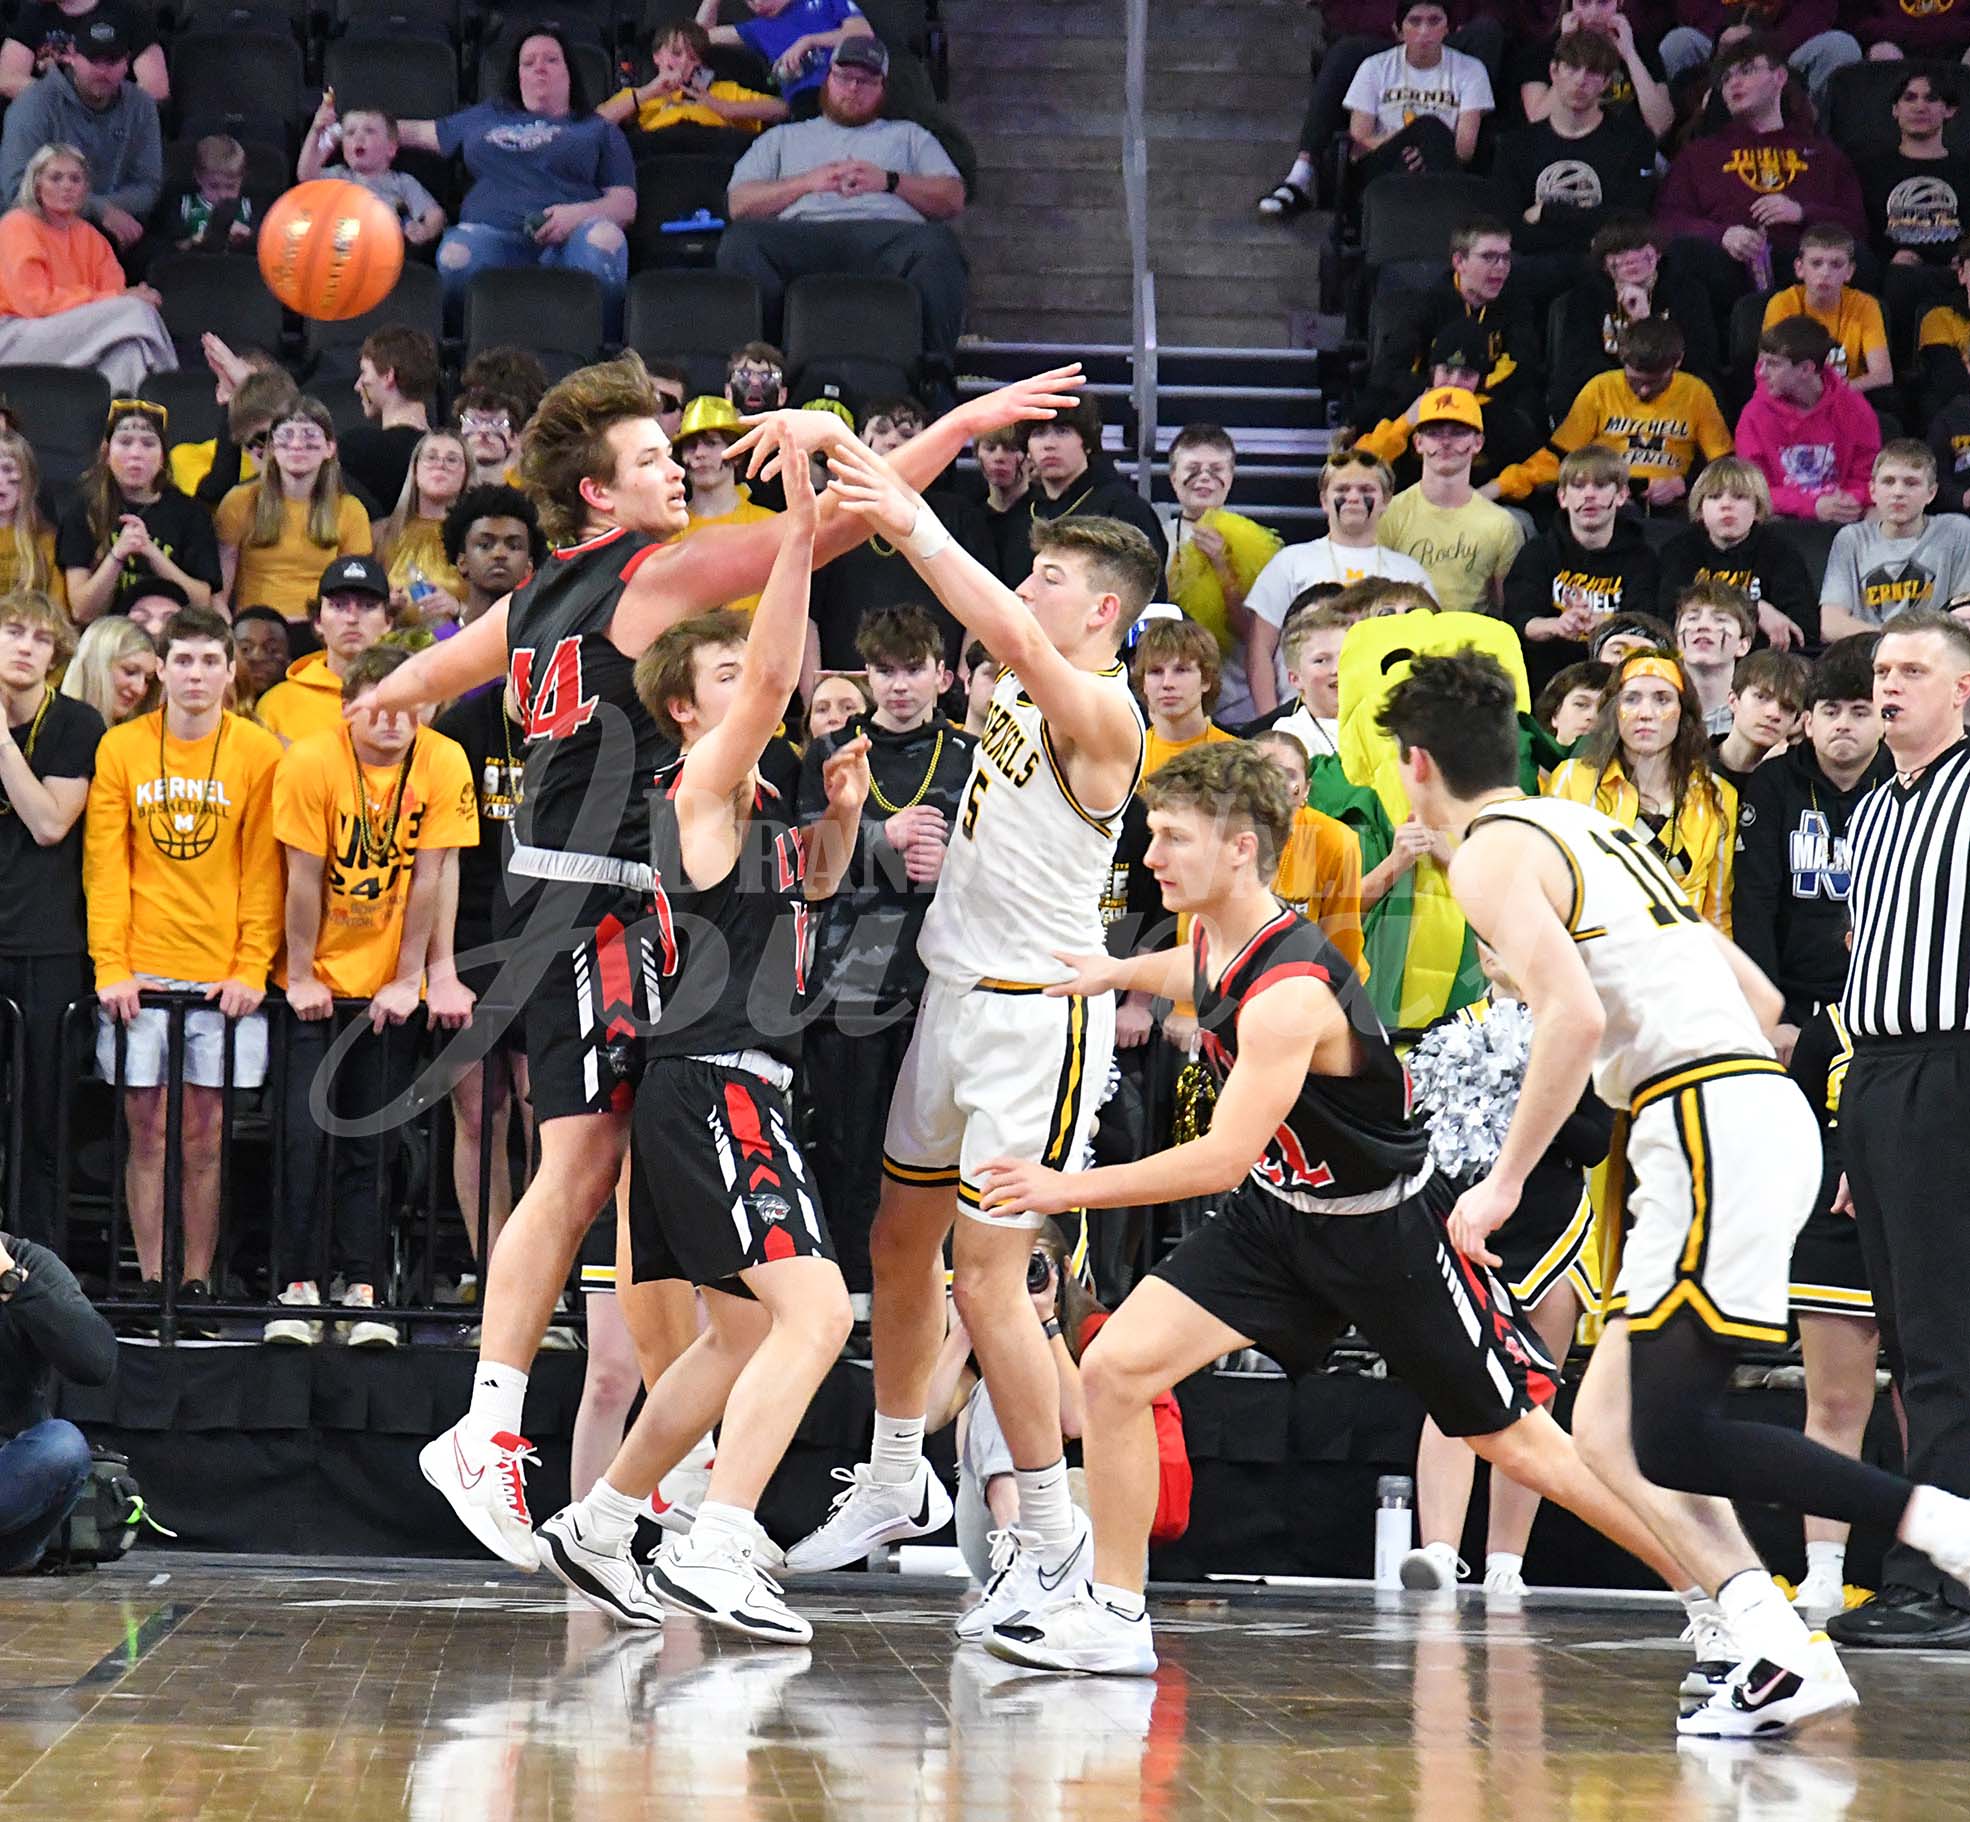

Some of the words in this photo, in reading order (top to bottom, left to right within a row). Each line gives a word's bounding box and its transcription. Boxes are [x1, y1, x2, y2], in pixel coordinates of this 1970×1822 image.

[1604, 416, 1688, 437] MITCHELL
[1407, 531, 1479, 573] Rocky
[136, 776, 231, 807] KERNEL
[962, 768, 991, 841] 5
[138, 800, 229, 820] BASKETBALL
[174, 813, 194, 832] M
